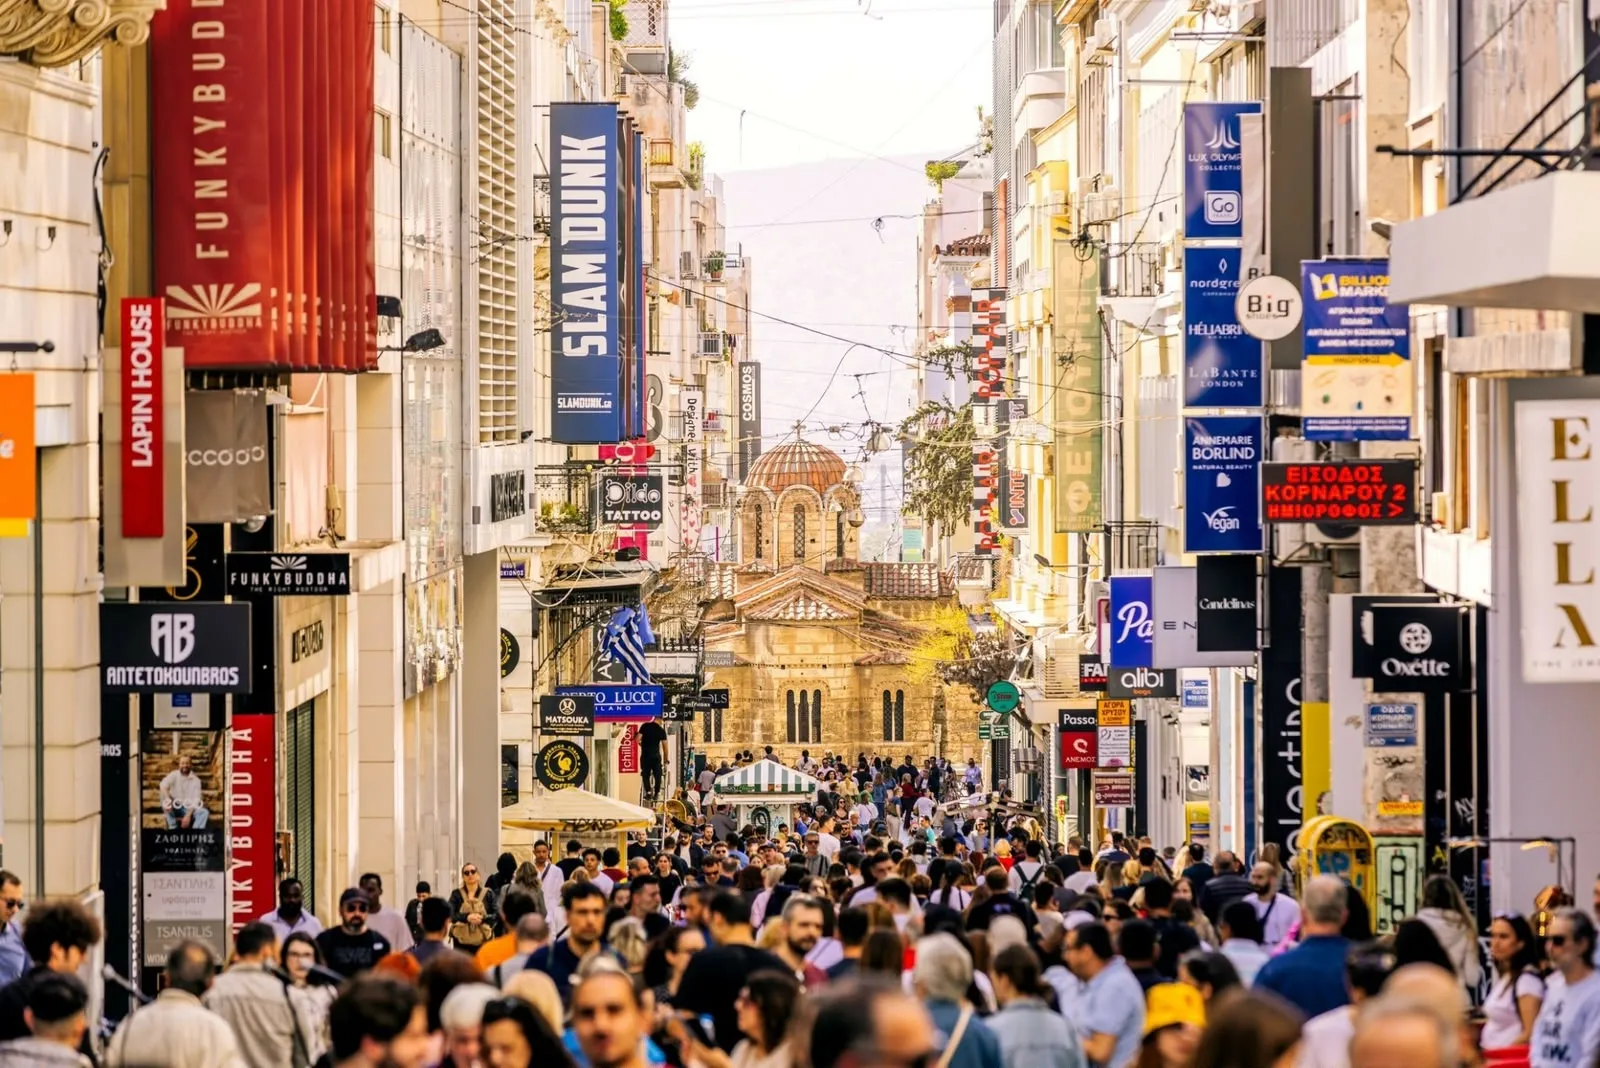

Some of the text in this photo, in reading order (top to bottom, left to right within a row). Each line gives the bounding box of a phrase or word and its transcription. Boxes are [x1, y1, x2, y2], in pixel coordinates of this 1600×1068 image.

[1188, 153, 1208, 163] LUX
[1211, 197, 1235, 213] Go
[560, 134, 607, 358] SLAMDUNK
[1247, 294, 1289, 318] Big
[130, 304, 153, 467] LAPIN HOUSE
[743, 366, 752, 421] COSMOS
[1192, 435, 1253, 445] ANNEMARIE
[1286, 466, 1383, 483] ΕΙΣΟΔΟΣ
[1265, 484, 1406, 501] ΚΟΡΝΑΡΟΥ 2
[605, 510, 662, 521] TATTOO
[1267, 503, 1382, 518] ΗΜΙΟΡΟΦΟΣ
[1202, 506, 1240, 534] Vegan
[230, 572, 347, 586] FUNKYBUDDHA
[150, 613, 196, 664] AB
[107, 666, 239, 686] ANTETOKOUNBROS
[1120, 667, 1164, 688] alibi
[614, 691, 655, 703] LUCCI
[545, 716, 589, 724] MATSOUKA
[1063, 713, 1098, 725] Passa
[622, 727, 632, 768] chillbox
[156, 925, 214, 938] TSANTILIS
